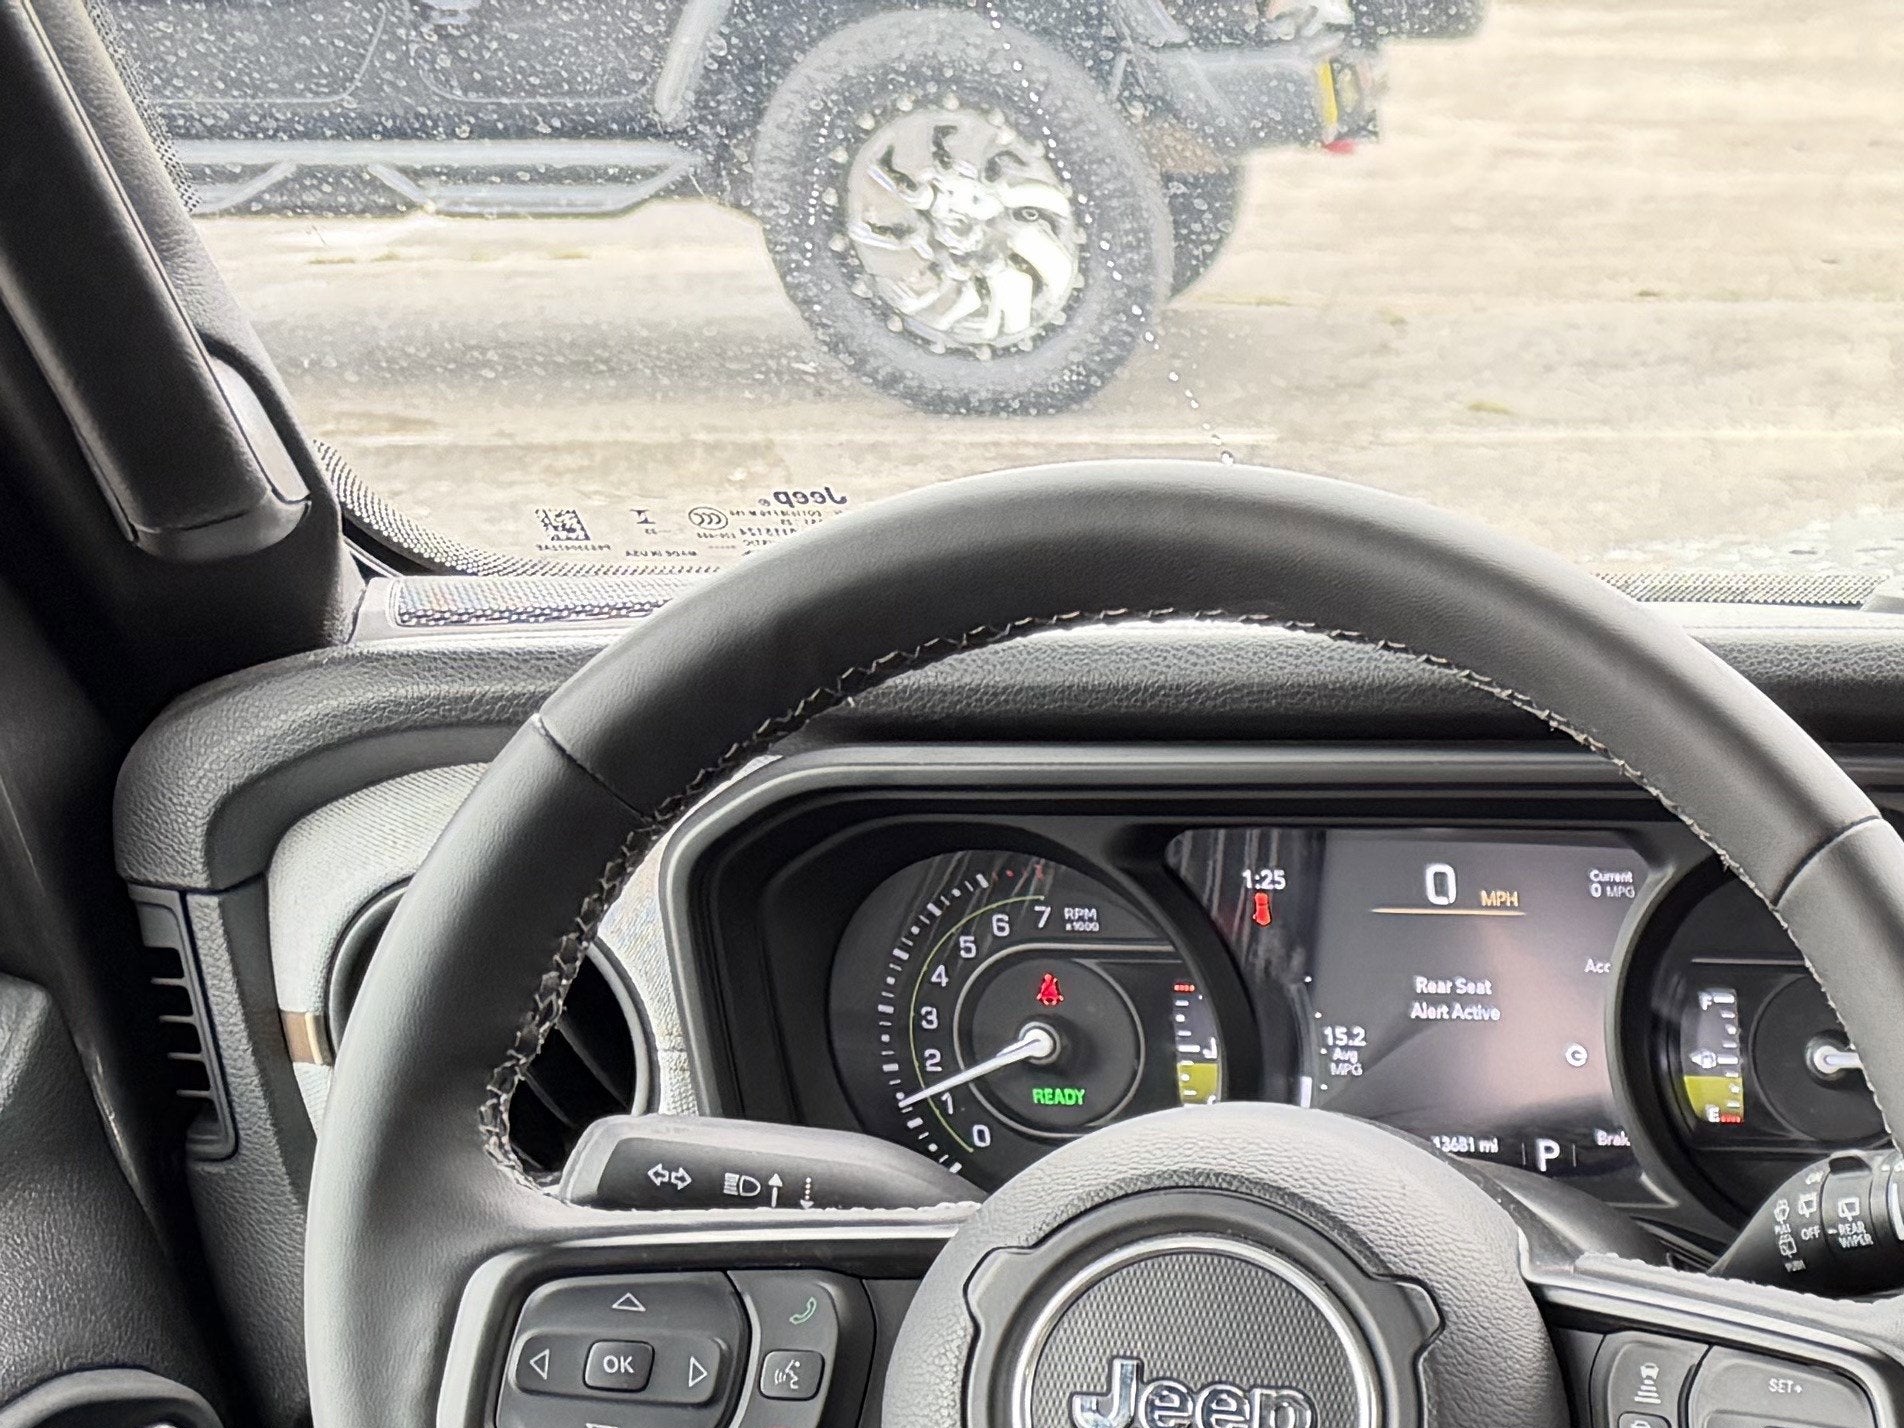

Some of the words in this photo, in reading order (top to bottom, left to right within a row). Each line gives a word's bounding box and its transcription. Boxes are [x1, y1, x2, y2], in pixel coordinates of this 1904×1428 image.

[1241, 868, 1286, 891] 1:25
[1424, 861, 1458, 906] 0
[1479, 889, 1519, 908] MPH
[1588, 868, 1634, 884] Current
[1606, 885, 1636, 898] MPG
[1034, 905, 1051, 929] 7
[1063, 906, 1098, 921] RPM
[991, 914, 1010, 937] 6
[959, 935, 977, 959] 5
[930, 964, 949, 987] 4
[1414, 975, 1452, 995] Rear
[1455, 977, 1493, 996] Seat
[920, 1006, 938, 1030] 3
[1410, 1003, 1449, 1020] Alert
[1451, 1004, 1501, 1022] Active
[1323, 1026, 1367, 1048] 15.2
[924, 1049, 943, 1072] 2
[1332, 1047, 1359, 1064] Avg
[1330, 1063, 1363, 1077] MPG
[940, 1092, 955, 1115] 1
[1032, 1087, 1086, 1106] READY
[971, 1124, 991, 1148] 0
[1535, 1137, 1561, 1172] P
[1800, 1225, 1821, 1241] OFF
[1837, 1220, 1867, 1236] REAR
[1838, 1232, 1874, 1249] WIPER
[602, 1354, 634, 1375] OK
